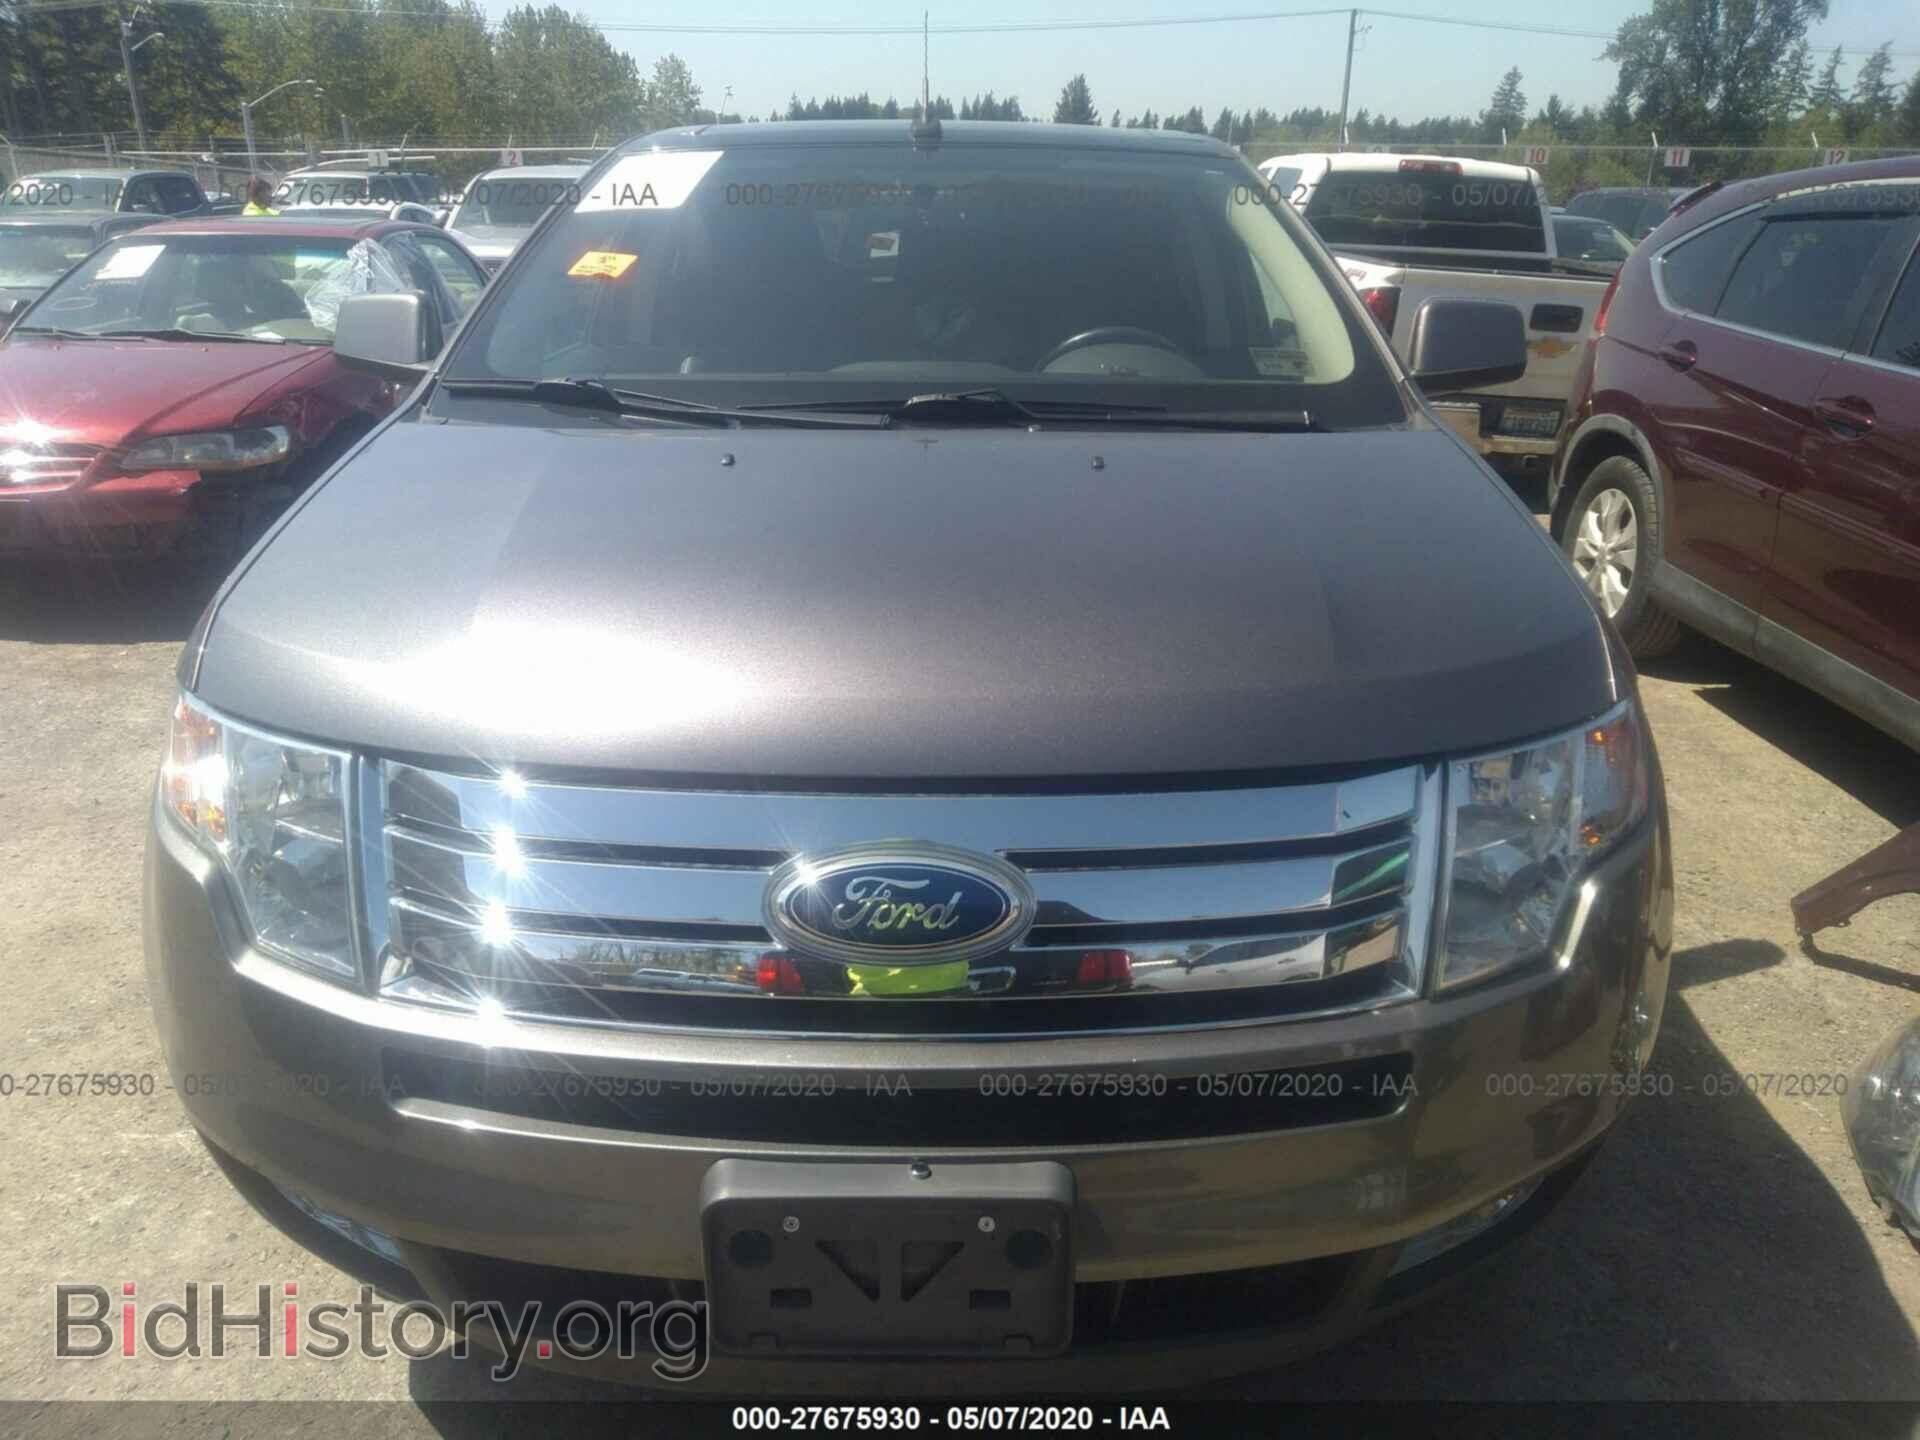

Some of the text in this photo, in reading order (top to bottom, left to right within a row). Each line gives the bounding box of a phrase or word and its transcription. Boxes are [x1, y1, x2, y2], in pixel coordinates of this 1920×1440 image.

[509, 150, 518, 166] 2
[1529, 147, 1546, 163] 10
[1829, 151, 1846, 165] 12
[832, 876, 962, 930] Ford
